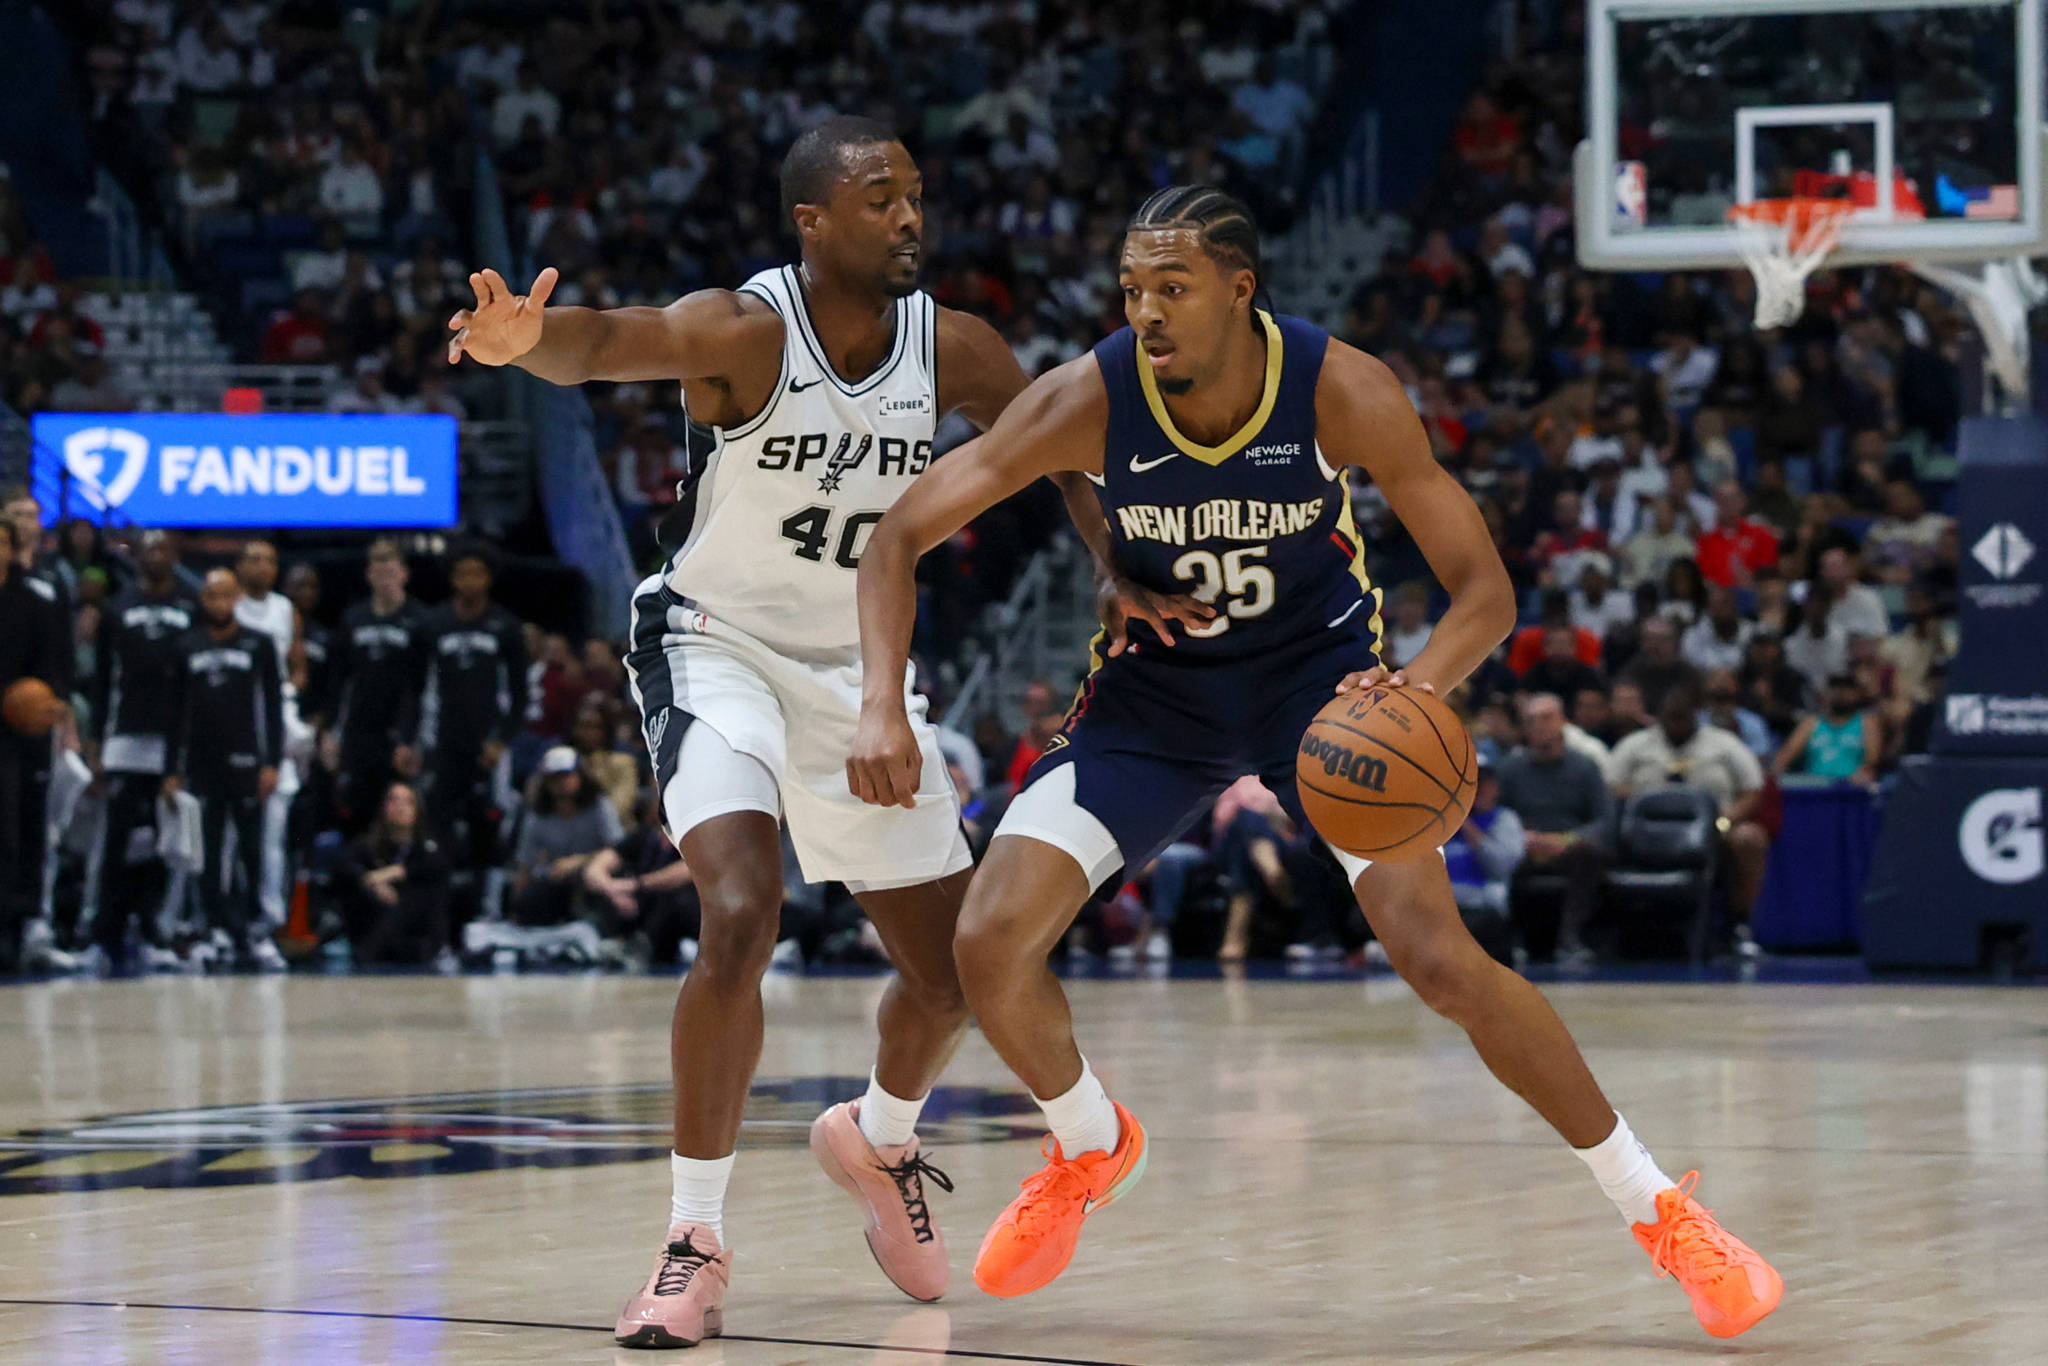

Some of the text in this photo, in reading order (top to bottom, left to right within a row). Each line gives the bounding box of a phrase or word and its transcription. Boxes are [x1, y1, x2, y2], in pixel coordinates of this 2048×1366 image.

[886, 400, 924, 411] LEDGER
[160, 445, 426, 496] FANDUEL
[757, 432, 932, 495] SPURS
[1245, 443, 1301, 460] NEWAGE
[1254, 457, 1291, 466] GARAGE
[1116, 497, 1324, 546] NEW ORLEANS
[1958, 786, 2045, 884] G
